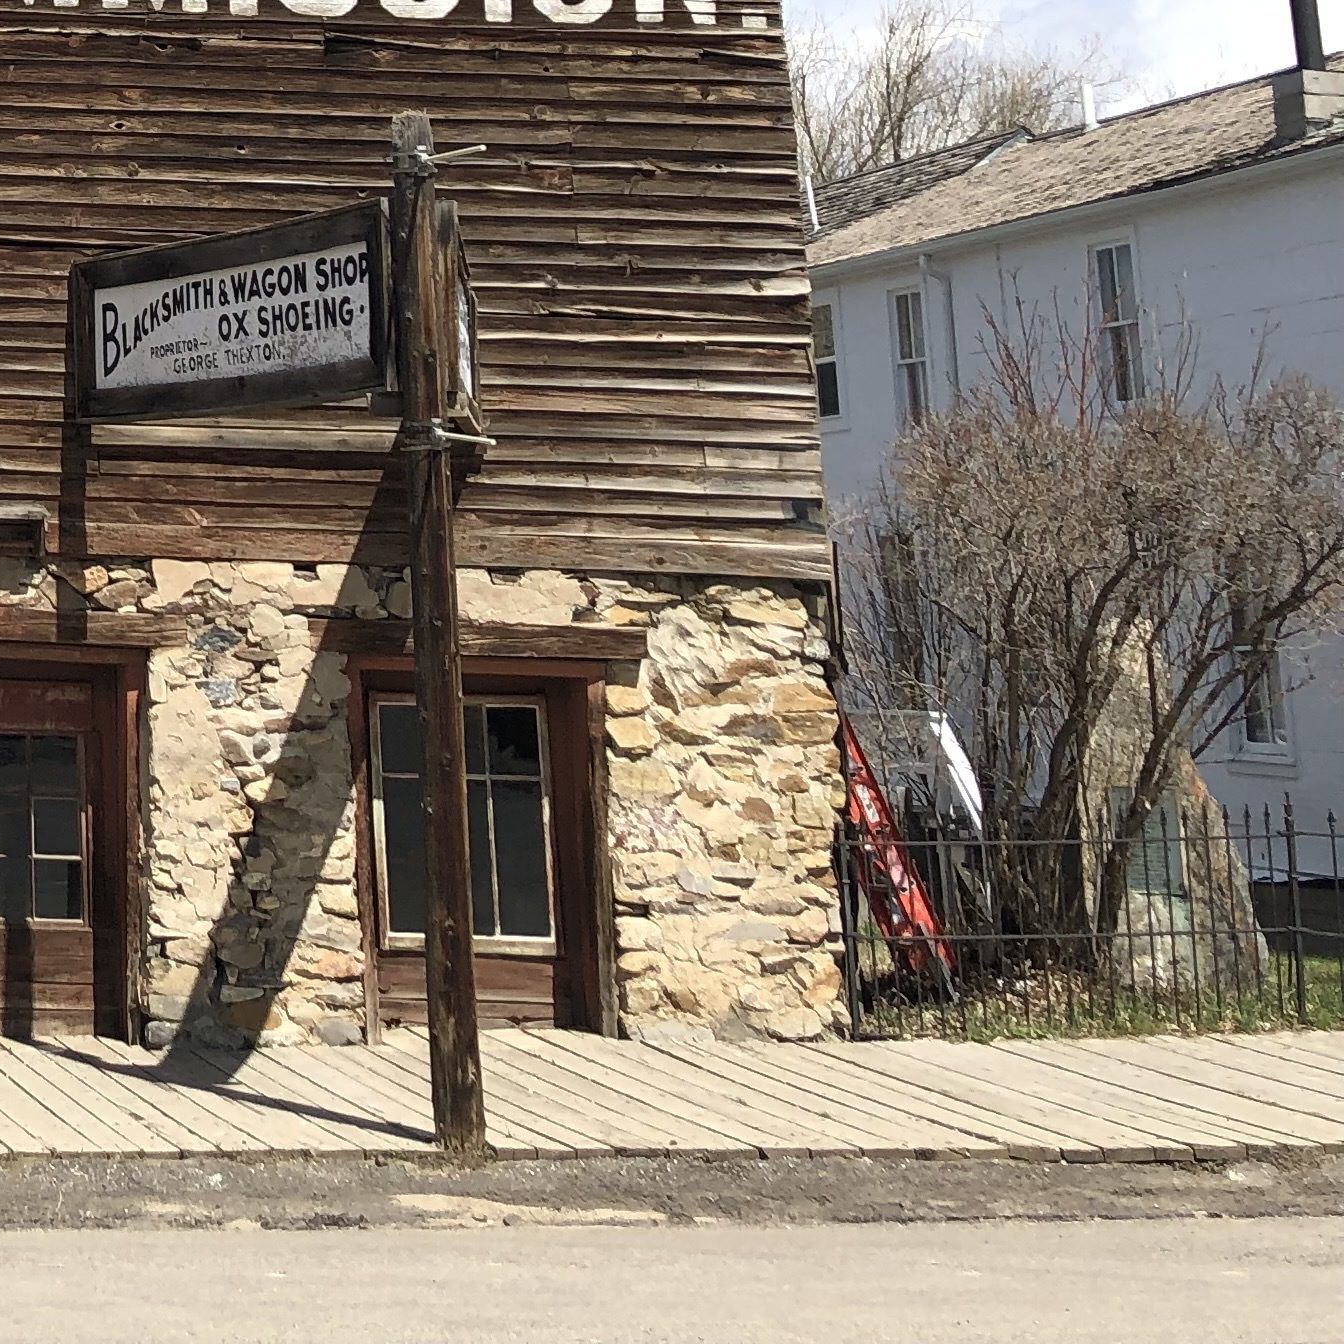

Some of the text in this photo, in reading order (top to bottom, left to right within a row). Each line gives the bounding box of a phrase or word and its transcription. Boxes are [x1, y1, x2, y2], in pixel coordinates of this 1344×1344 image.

[102, 252, 369, 378] BLACKSMITH & WAGON SHOP
[218, 310, 250, 342] OX
[173, 352, 219, 374] GEORGE
